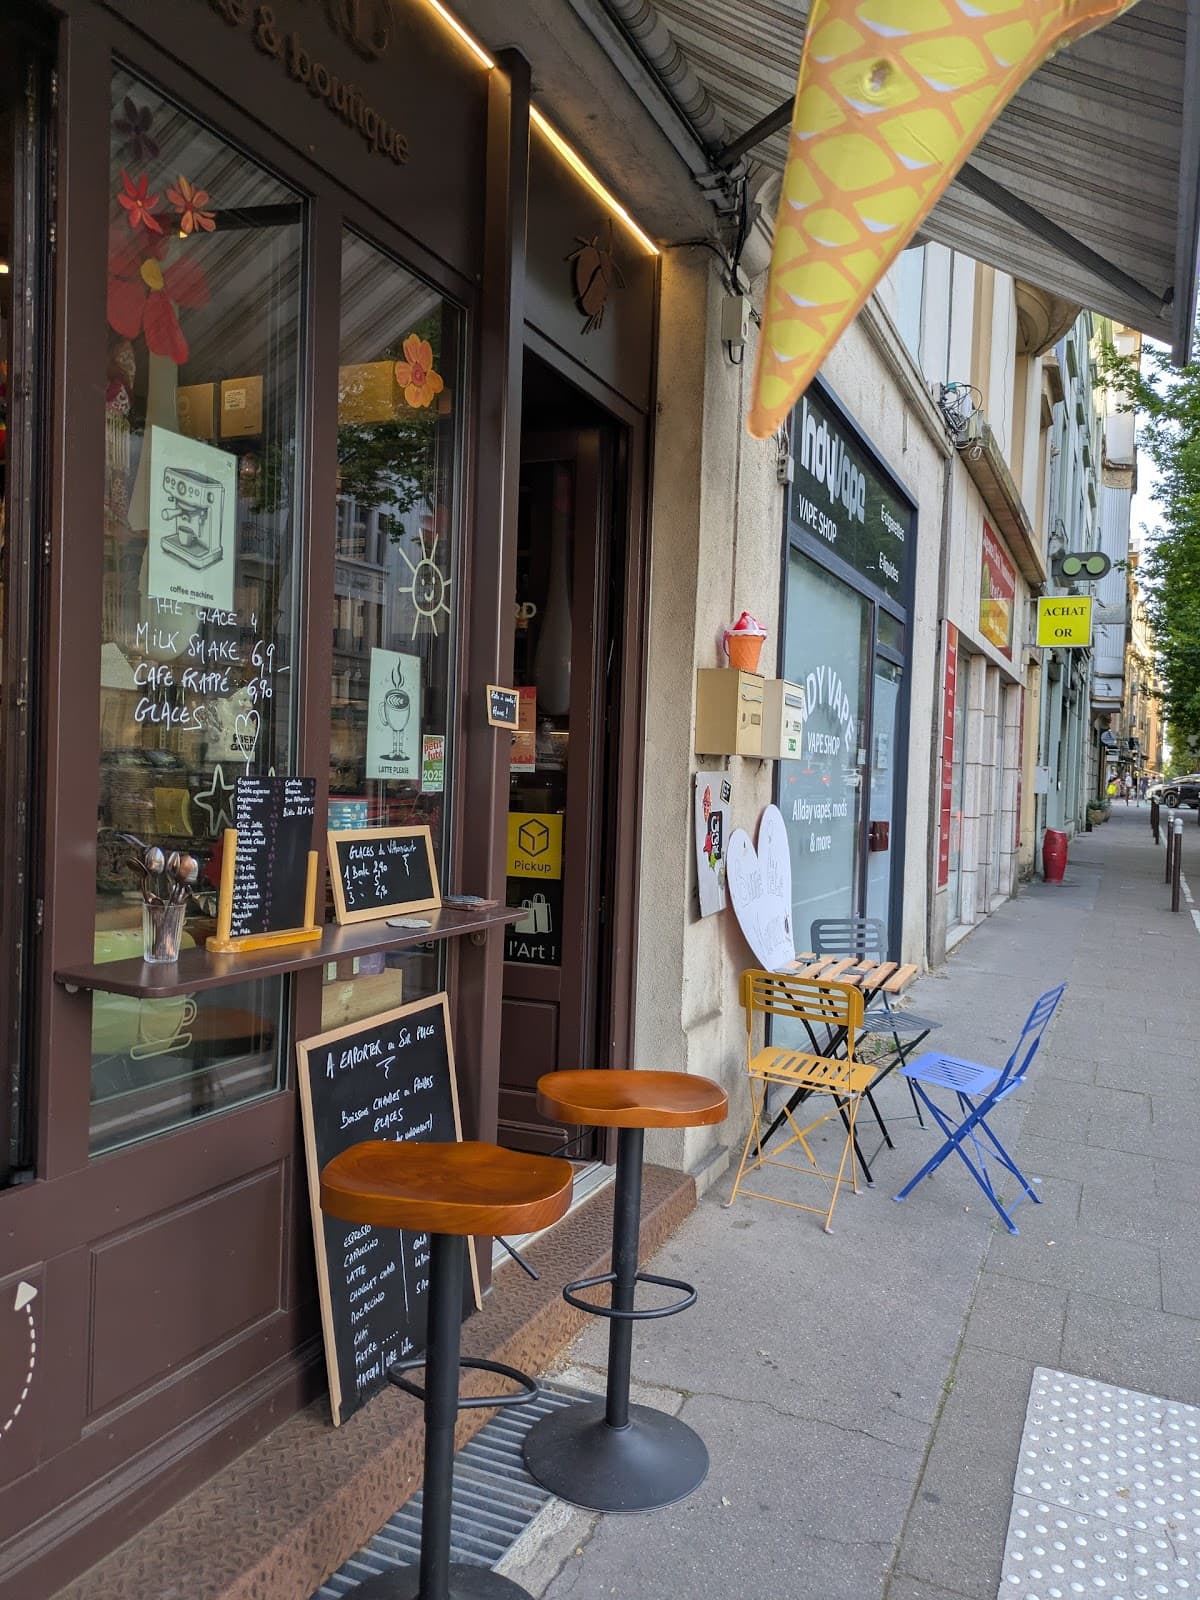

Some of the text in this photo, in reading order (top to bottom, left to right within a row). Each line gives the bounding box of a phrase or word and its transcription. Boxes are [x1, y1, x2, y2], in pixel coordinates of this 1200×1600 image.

[291, 32, 409, 164] boutique
[799, 494, 838, 543] VAPE SHOP
[169, 585, 214, 601] coffee machine
[196, 608, 238, 626] GLACE
[1043, 605, 1086, 618] ACHAT
[1054, 627, 1072, 638] OR
[188, 634, 240, 664] SHAKE
[134, 697, 206, 731] GLACES
[828, 666, 855, 753] VAPE
[807, 731, 825, 753] VAPE
[824, 736, 841, 756] SHOP
[378, 766, 392, 774] LATTE
[423, 770, 443, 781] 2025
[792, 799, 848, 824] Allday vapes, mods
[809, 833, 832, 852] & more
[349, 845, 375, 860] GLACES
[514, 859, 552, 874] Pickup
[346, 880, 353, 890] 2
[348, 891, 355, 904] 3
[326, 1052, 335, 1079] A
[343, 1224, 372, 1248] ESPRESSO
[346, 1264, 368, 1284] LATTE
